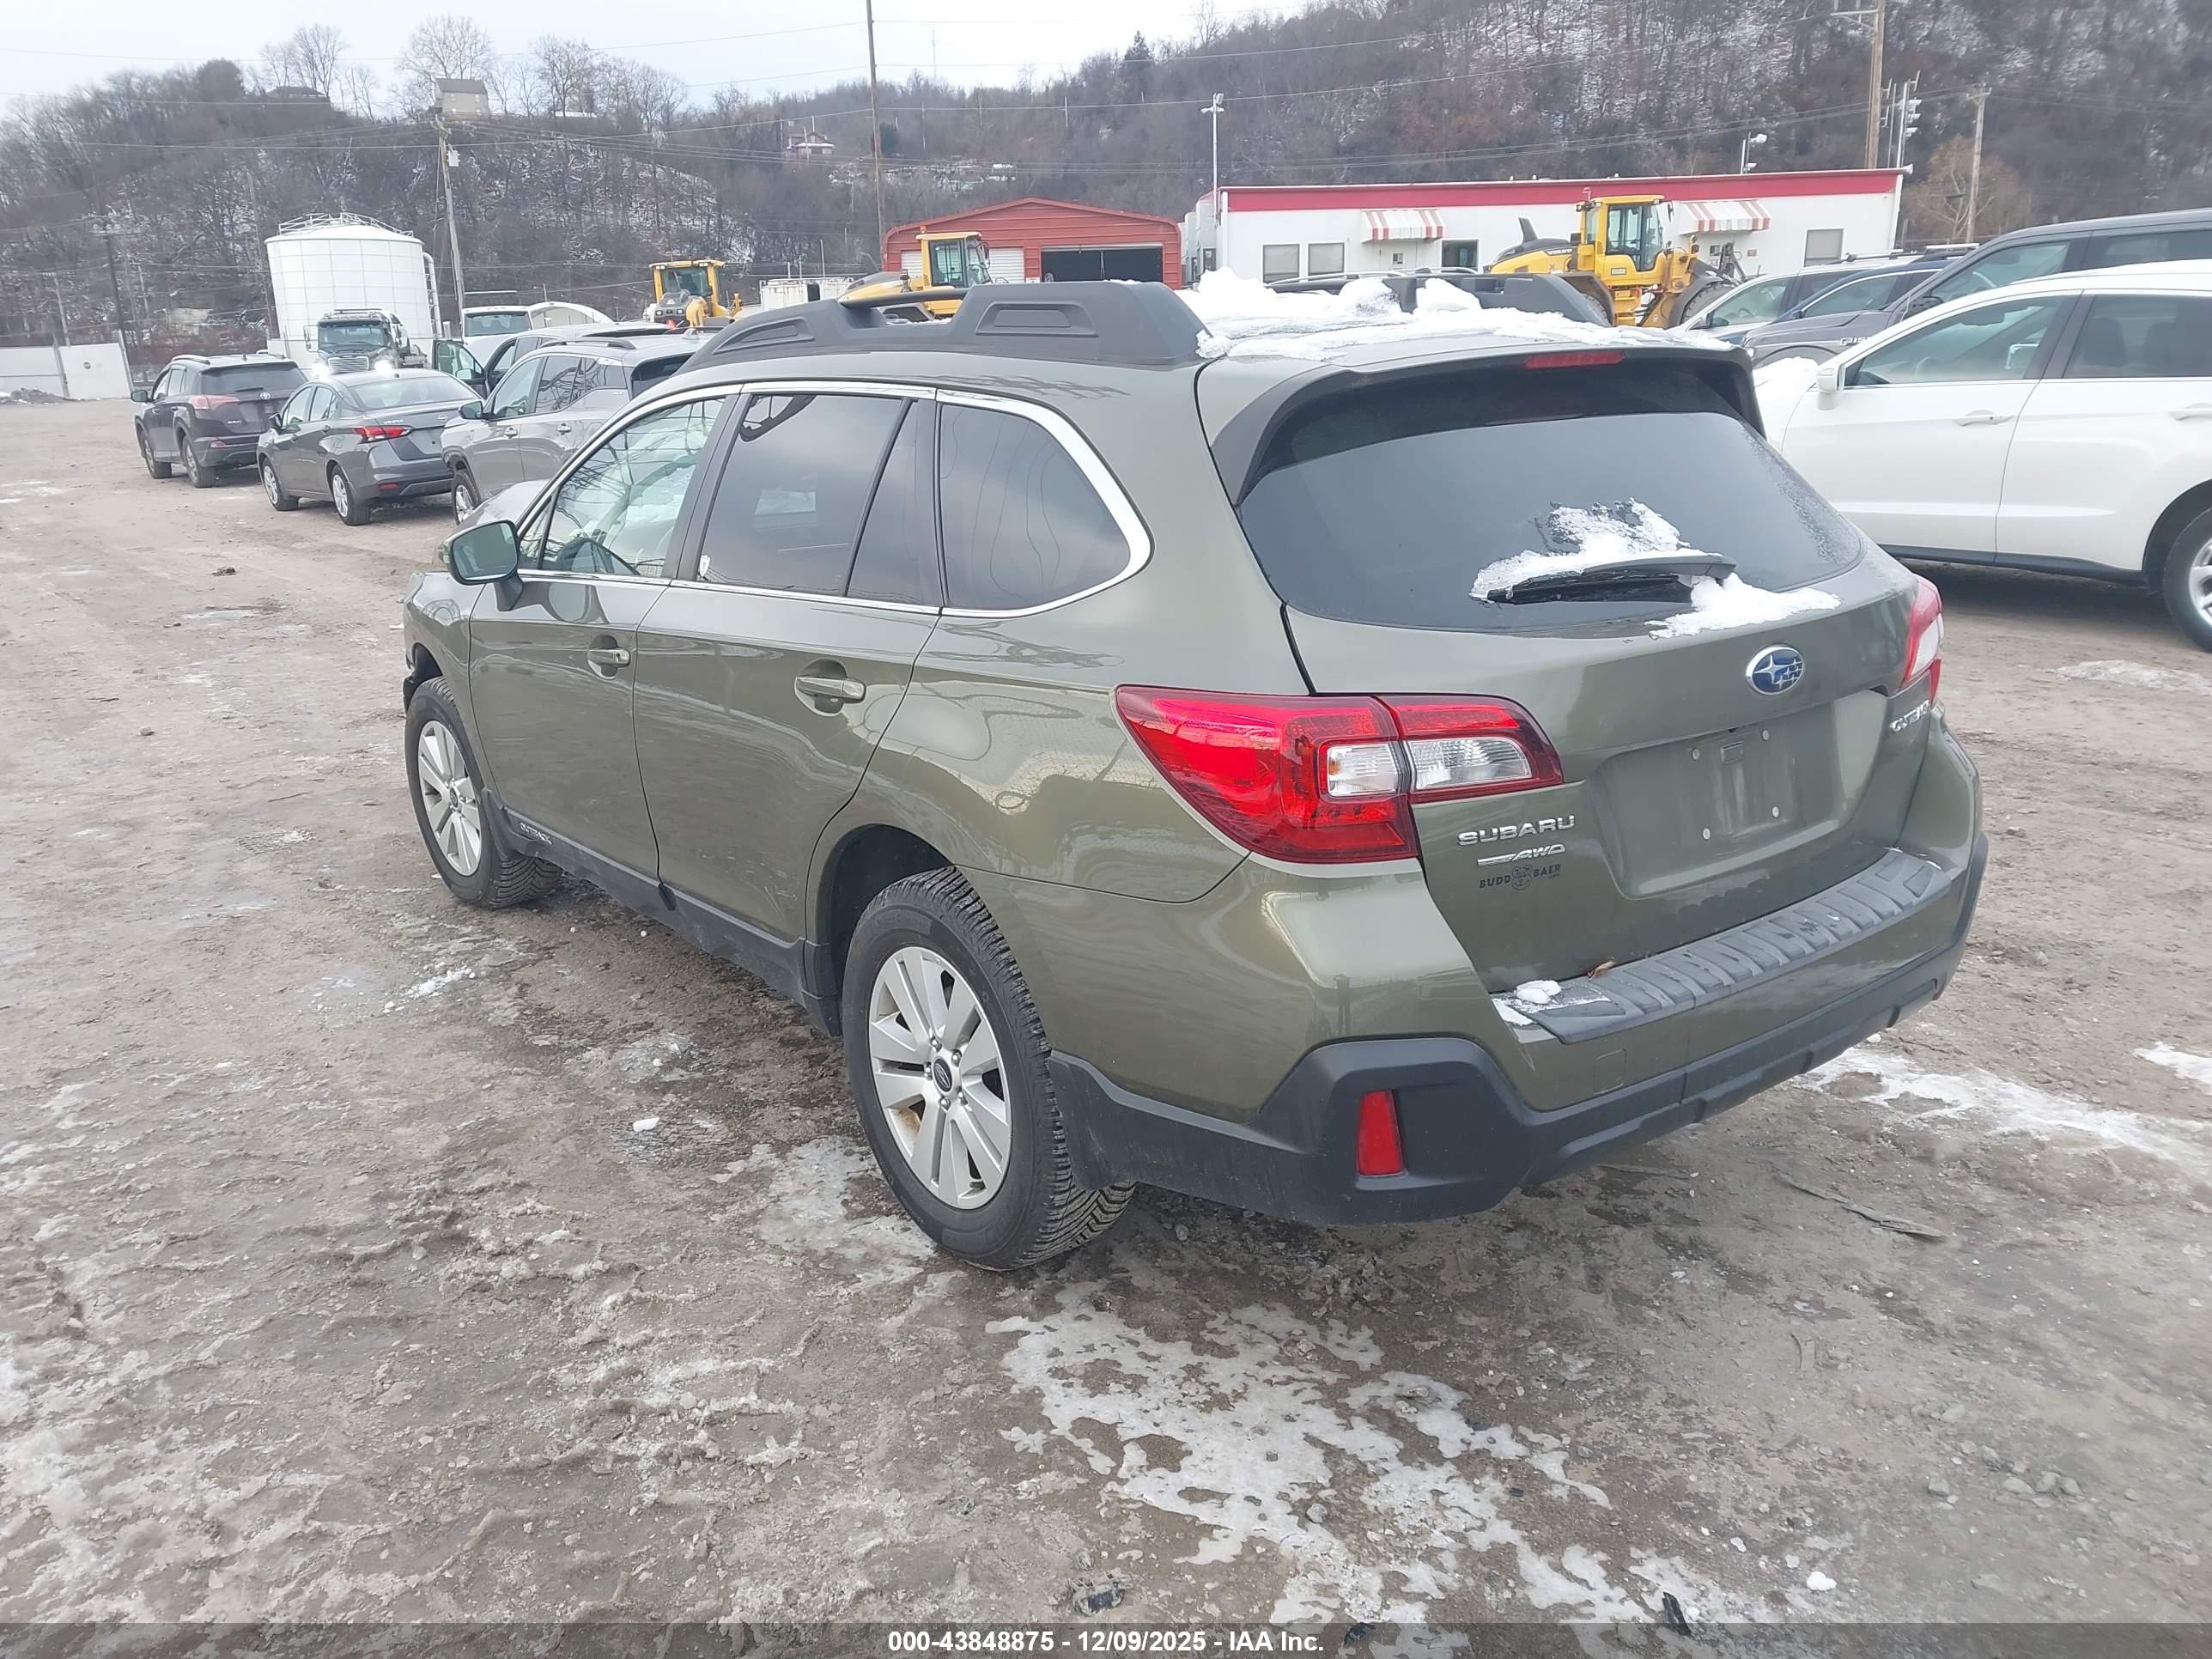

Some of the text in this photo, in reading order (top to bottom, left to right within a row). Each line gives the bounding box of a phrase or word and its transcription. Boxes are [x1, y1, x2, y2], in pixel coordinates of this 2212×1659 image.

[1458, 815, 1575, 846] SUBARU
[1511, 843, 1565, 861] AWD
[1479, 874, 1511, 889] BUDD
[1533, 864, 1561, 878] BAER
